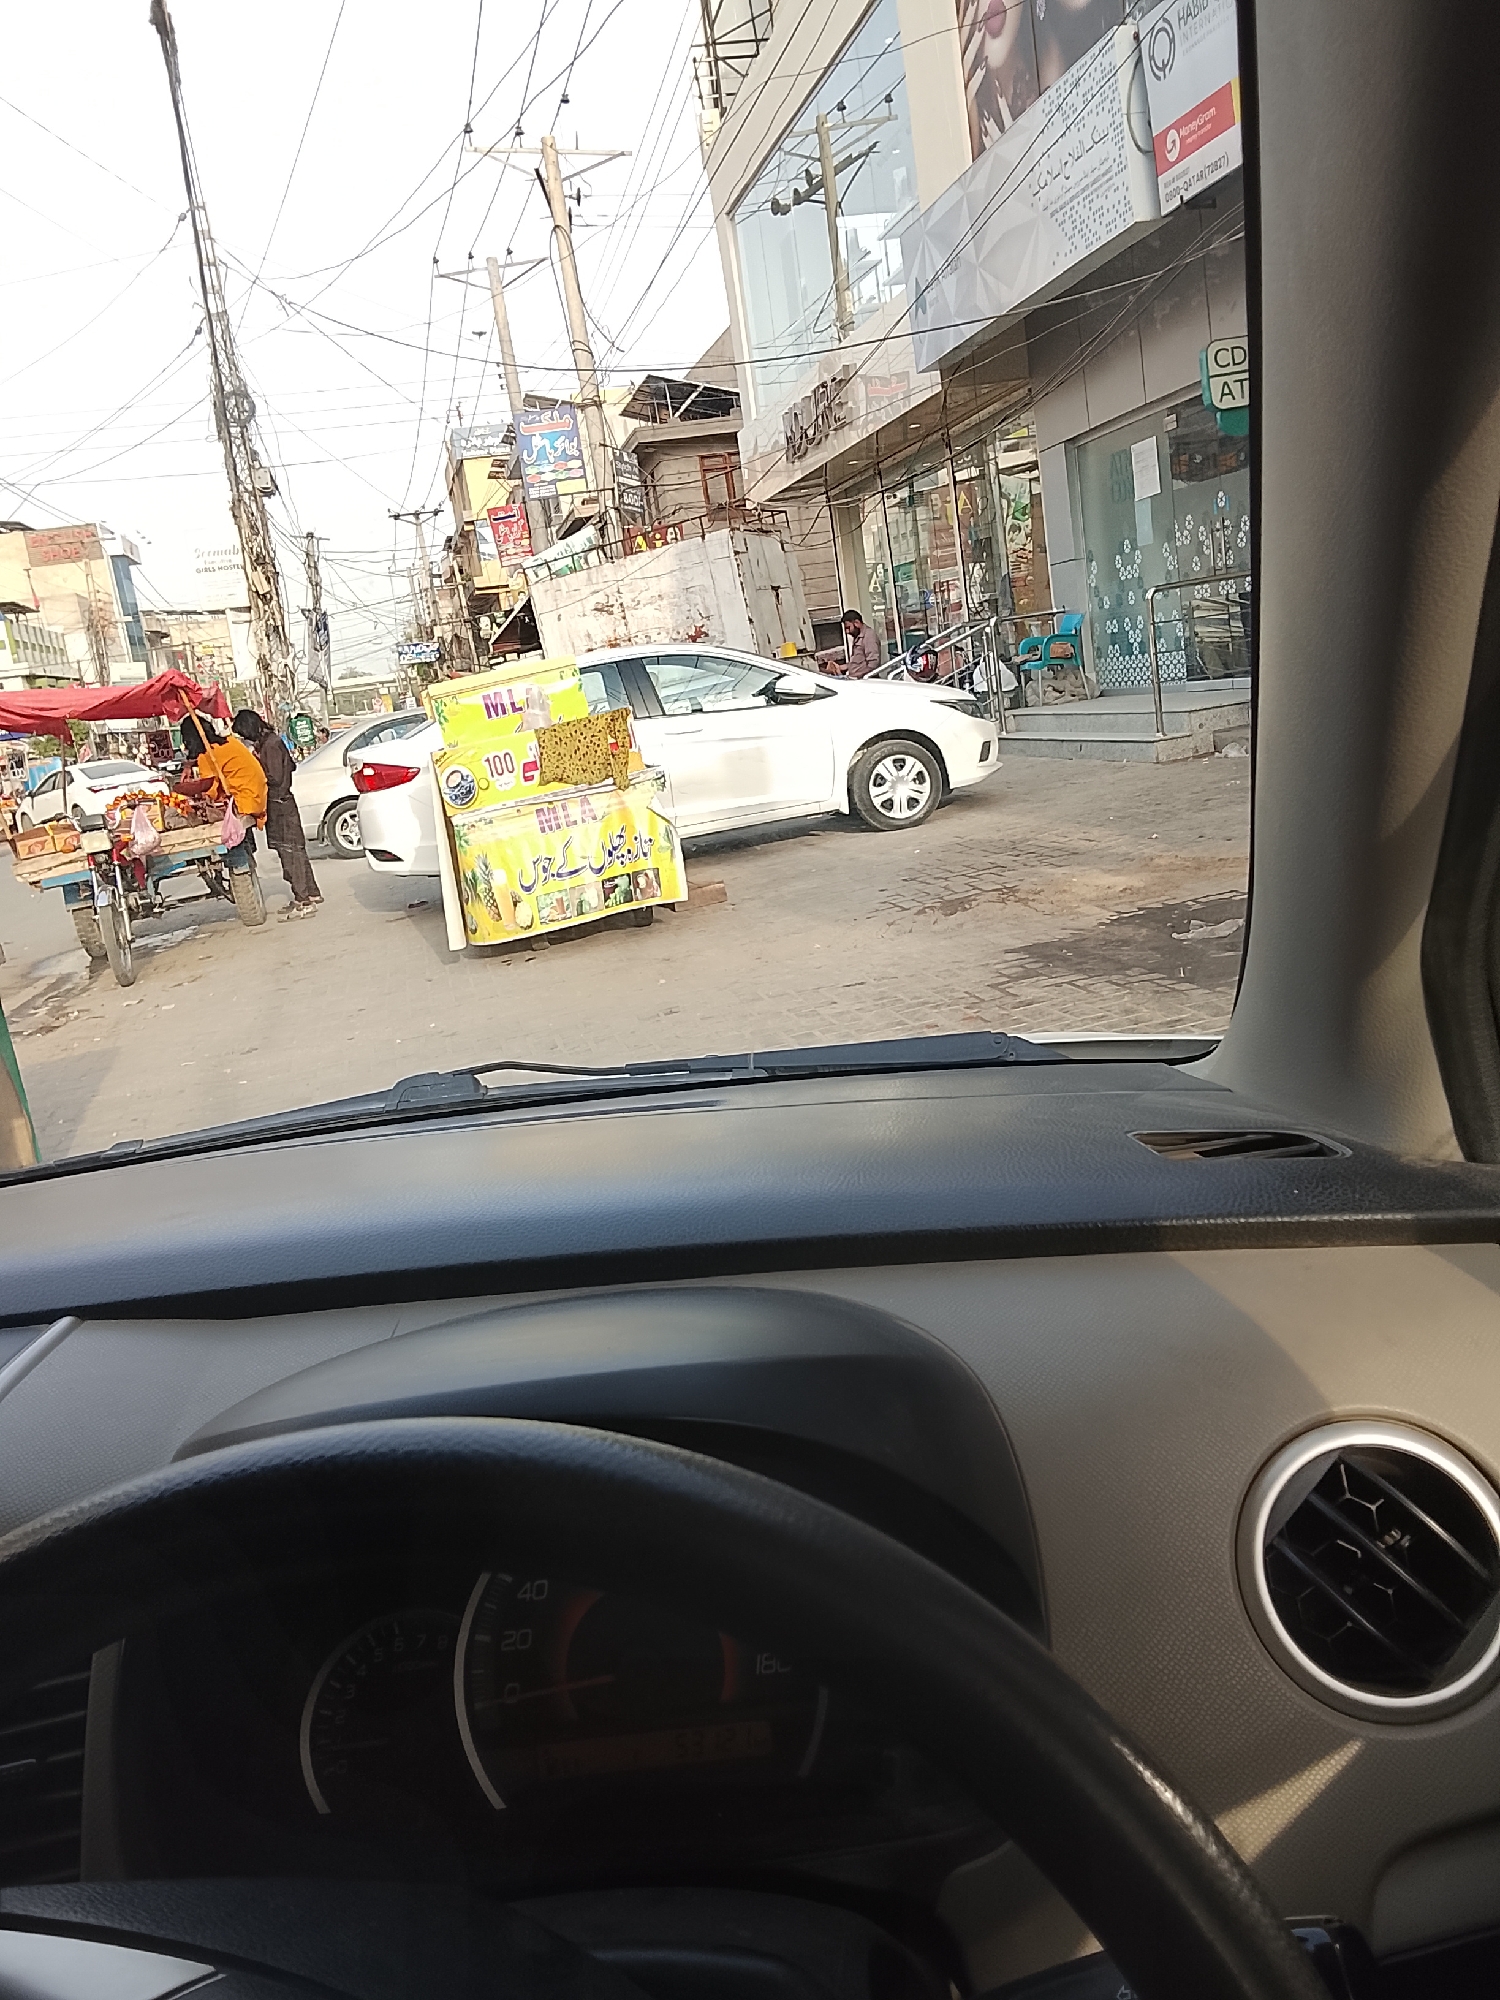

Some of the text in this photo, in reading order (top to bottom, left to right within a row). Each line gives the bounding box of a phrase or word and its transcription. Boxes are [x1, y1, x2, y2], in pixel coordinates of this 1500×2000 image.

[1180, 0, 1234, 46] INTERNATIO
[1179, 107, 1216, 139] MoneyGram
[484, 752, 515, 778] 100
[519, 824, 655, 893] تازہ پھلوں کے جوس
[517, 1579, 549, 1602] 40
[501, 1629, 533, 1652] 20
